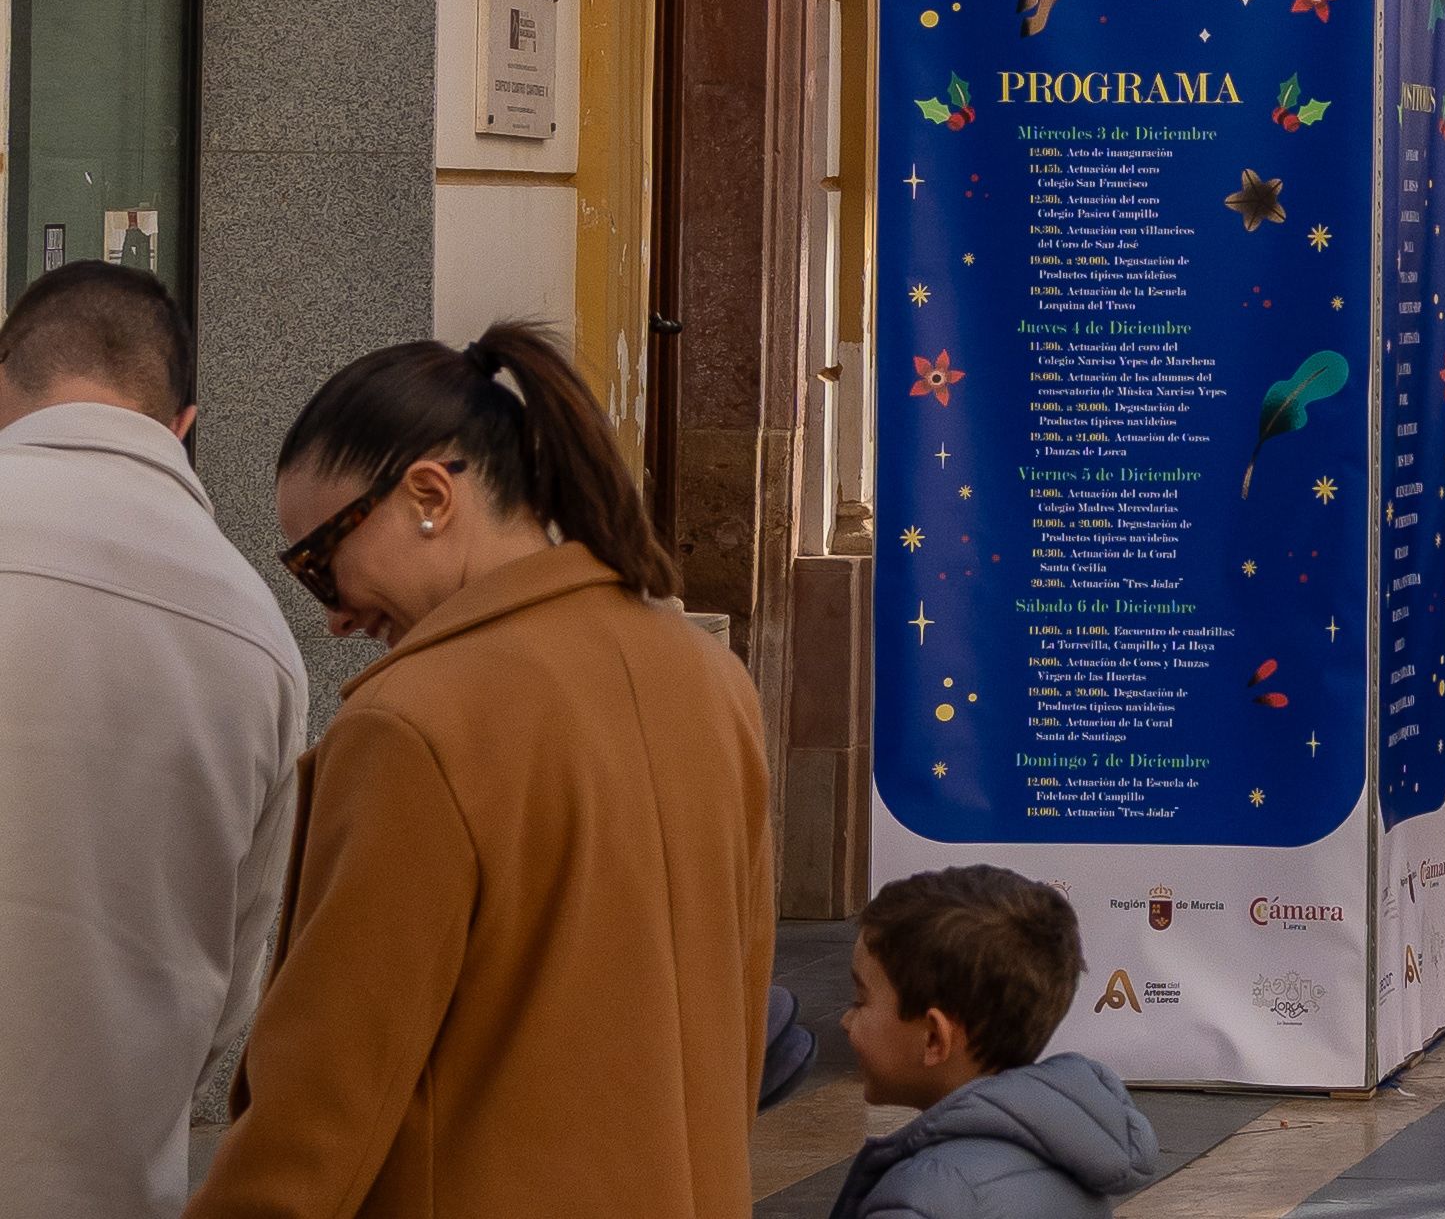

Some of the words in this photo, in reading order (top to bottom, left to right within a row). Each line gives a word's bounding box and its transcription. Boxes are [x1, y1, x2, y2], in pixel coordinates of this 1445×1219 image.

[997, 72, 1243, 105] PROGRAMA
[1017, 126, 1093, 140] Miércoles
[1096, 127, 1107, 140] 3
[1110, 127, 1129, 140] de
[1135, 127, 1217, 141] Diciembre
[1075, 179, 1096, 188] San
[1119, 195, 1135, 205] del
[1037, 239, 1053, 249] del
[1094, 241, 1115, 249] San
[1116, 240, 1139, 249] José
[1087, 301, 1103, 310] del
[1017, 320, 1067, 334] Jueves
[1073, 321, 1080, 335] 4
[1085, 321, 1104, 335] de
[1110, 321, 1192, 335] Diciembre
[1018, 467, 1078, 481] Viernes
[1081, 468, 1091, 481] 5
[1095, 468, 1114, 481] de
[1120, 468, 1202, 482] Diciembre
[1015, 599, 1073, 613] Sábado
[1077, 600, 1087, 613] 6
[1091, 600, 1109, 613] de
[1115, 600, 1197, 614] Diciembre
[1016, 753, 1087, 770] Domingo
[1091, 754, 1098, 767] 7
[1105, 754, 1124, 767] de
[1130, 754, 1210, 768] Diciembre
[1110, 899, 1146, 911] Región
[1176, 901, 1188, 910] de
[1191, 900, 1225, 911] Murcia
[1249, 896, 1344, 926] Cámara
[1283, 922, 1307, 931] Lorca
